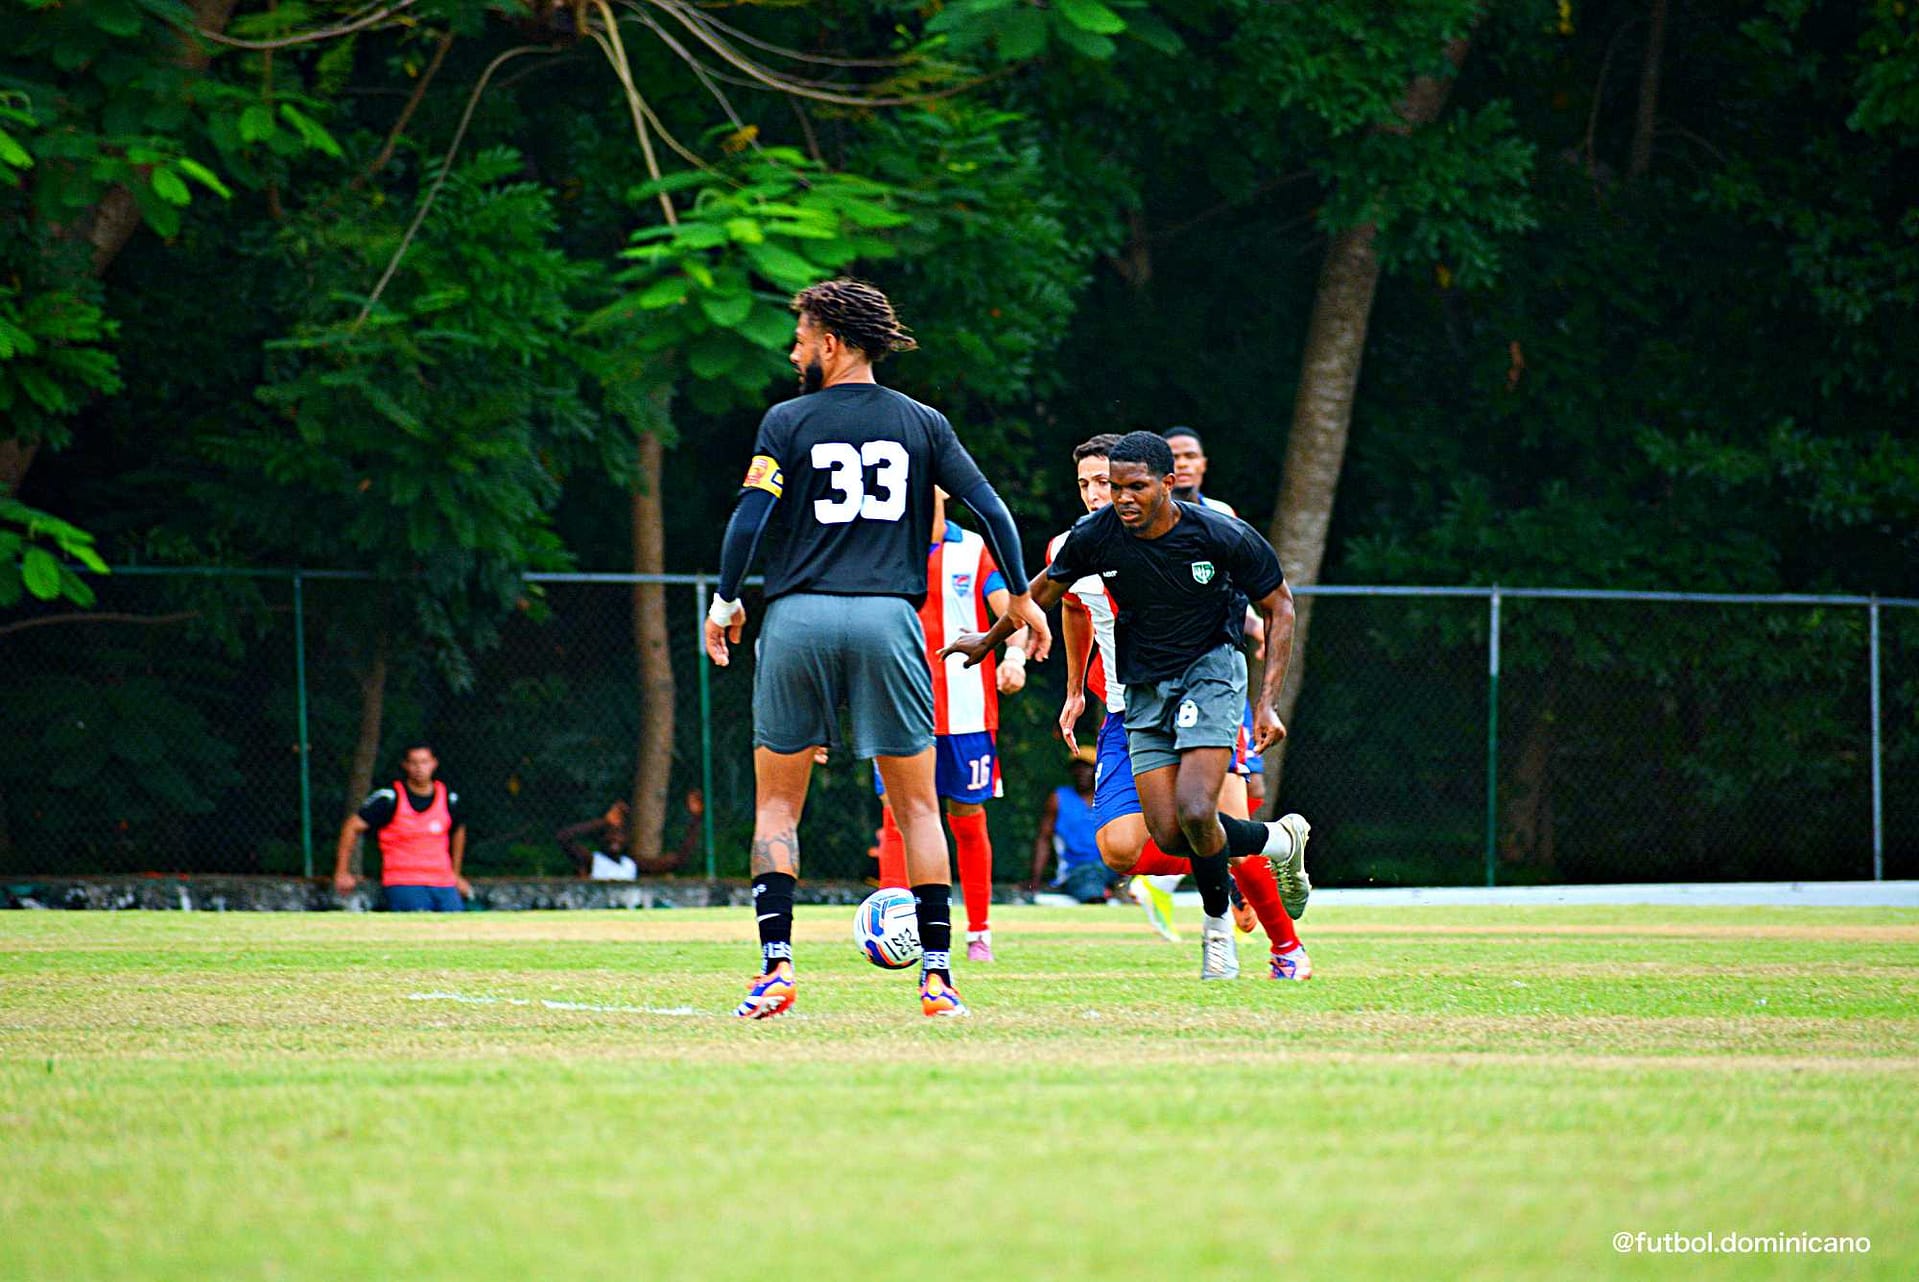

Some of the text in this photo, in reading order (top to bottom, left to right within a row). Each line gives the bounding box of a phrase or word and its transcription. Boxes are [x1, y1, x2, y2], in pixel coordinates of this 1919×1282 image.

[810, 440, 910, 524] 33
[1177, 699, 1199, 728] 8
[966, 754, 991, 790] 16
